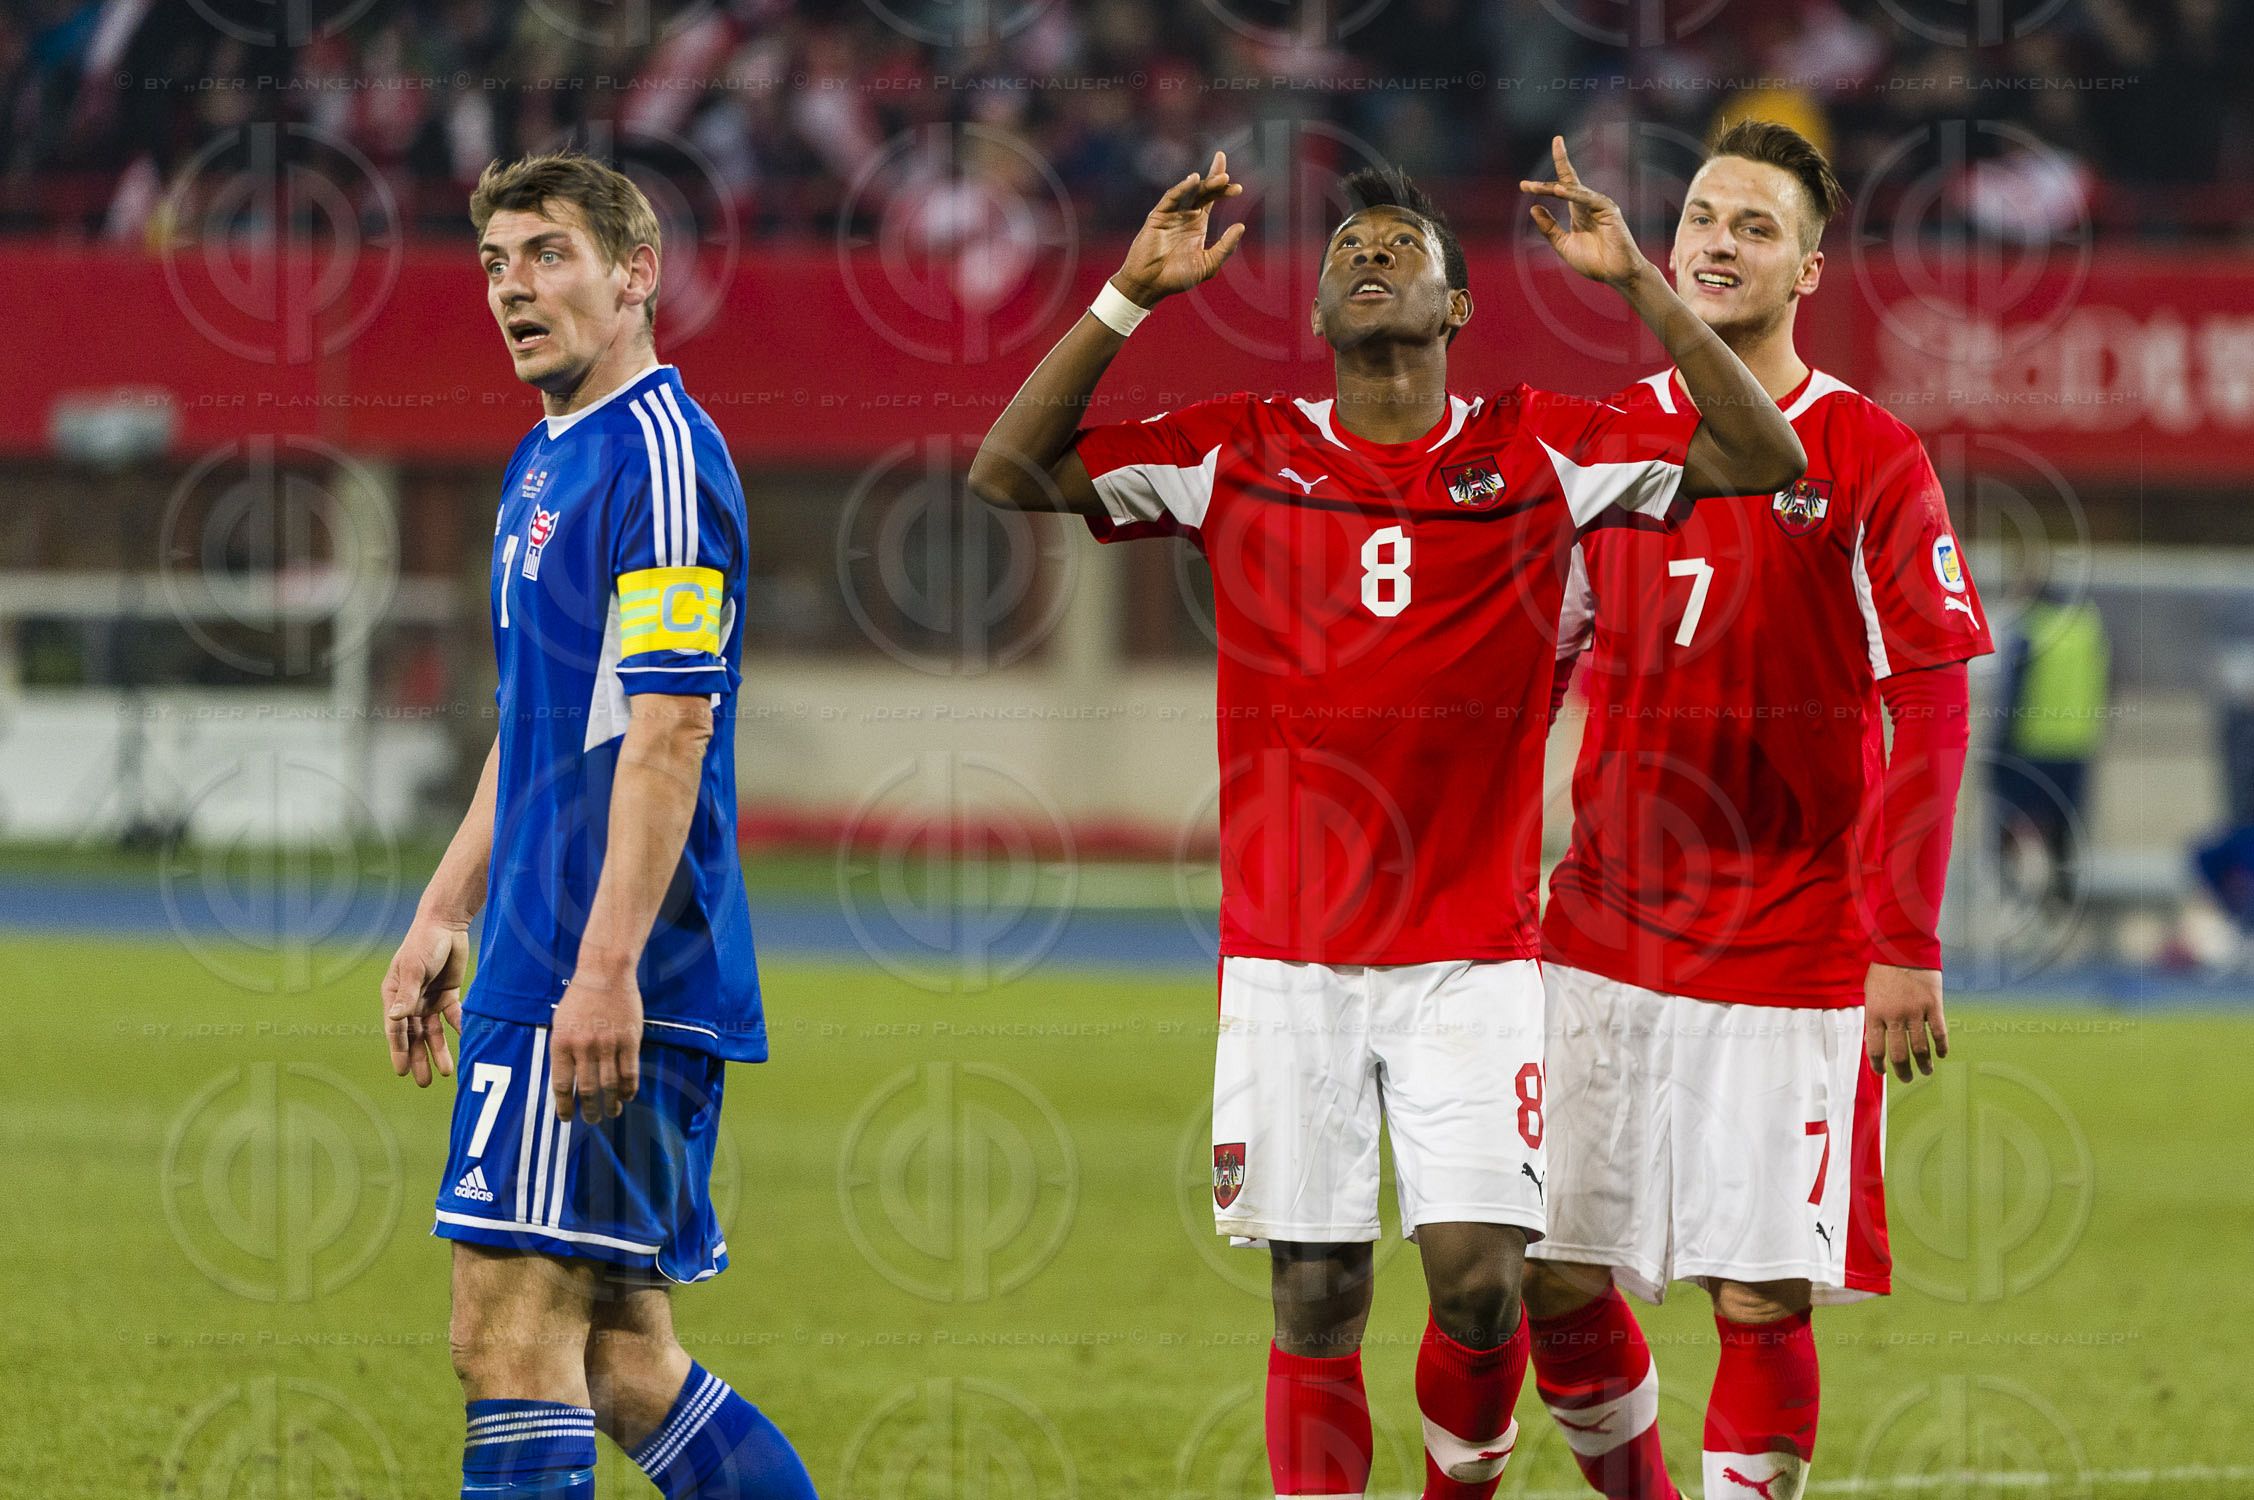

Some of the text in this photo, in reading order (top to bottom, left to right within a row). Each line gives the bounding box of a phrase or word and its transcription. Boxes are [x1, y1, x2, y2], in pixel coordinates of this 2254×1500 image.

[662, 583, 704, 633] C
[1361, 525, 1411, 617] 8
[1668, 557, 1715, 647] 7
[467, 1062, 512, 1158] 7
[1515, 1062, 1544, 1149] 8
[455, 1184, 494, 1202] adidas
[1805, 1120, 1829, 1206] 7
